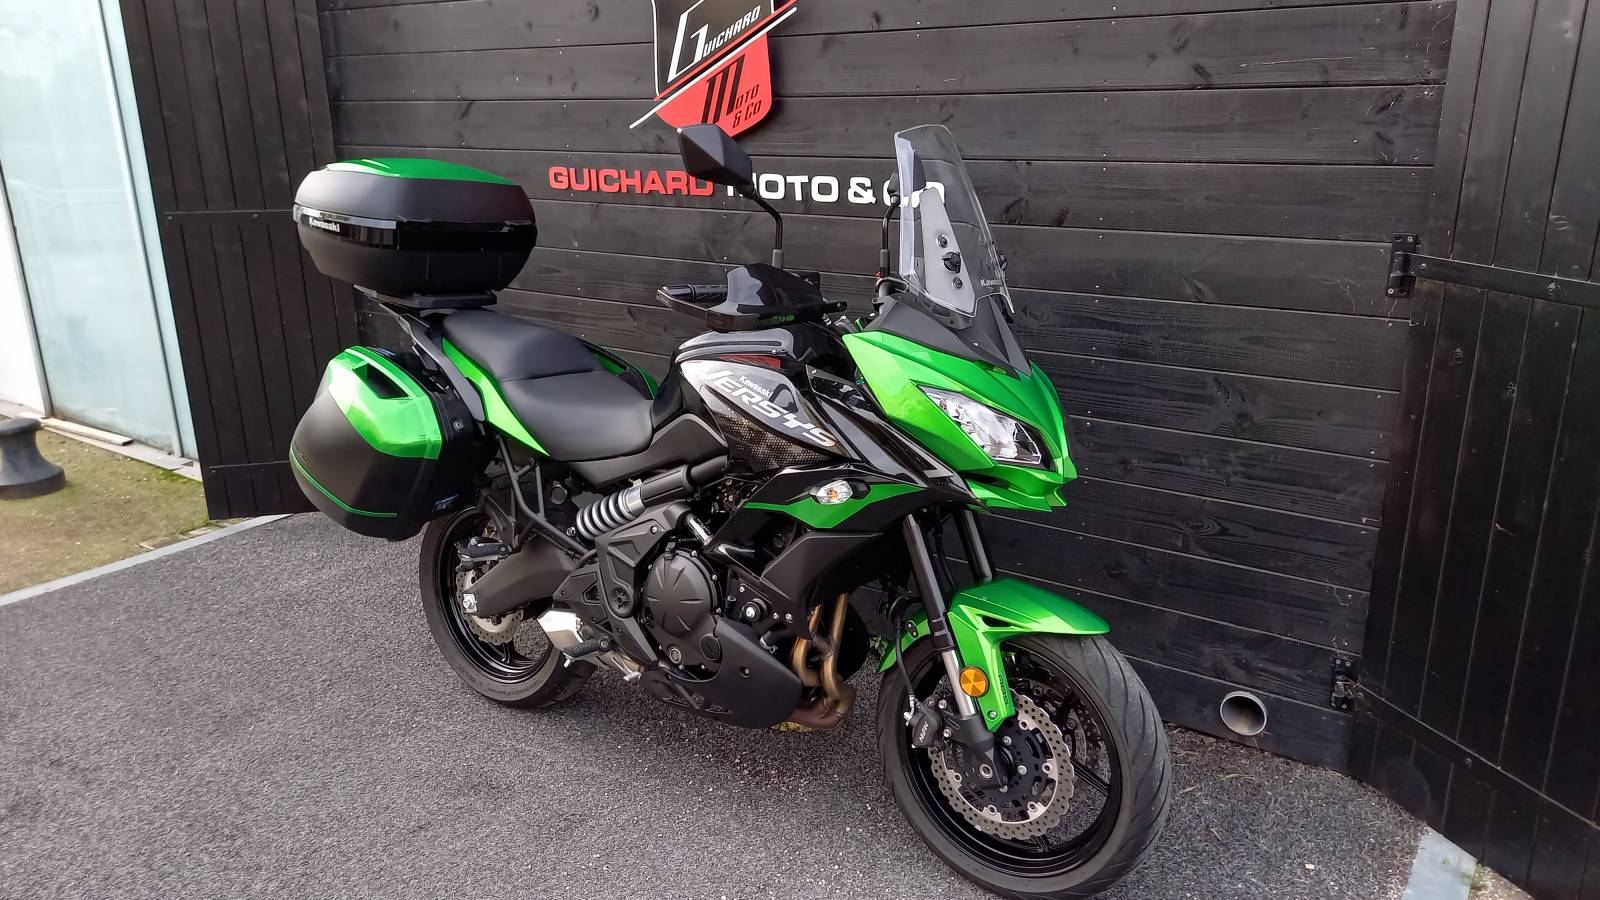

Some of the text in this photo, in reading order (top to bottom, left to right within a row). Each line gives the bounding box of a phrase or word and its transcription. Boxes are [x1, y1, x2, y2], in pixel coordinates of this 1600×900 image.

[667, 0, 761, 83] GUICHARD
[701, 53, 760, 124] MOTO
[548, 166, 714, 196] GUICHARD
[727, 172, 839, 203] OTO
[847, 176, 876, 205] &
[738, 375, 773, 399] Kawasaki
